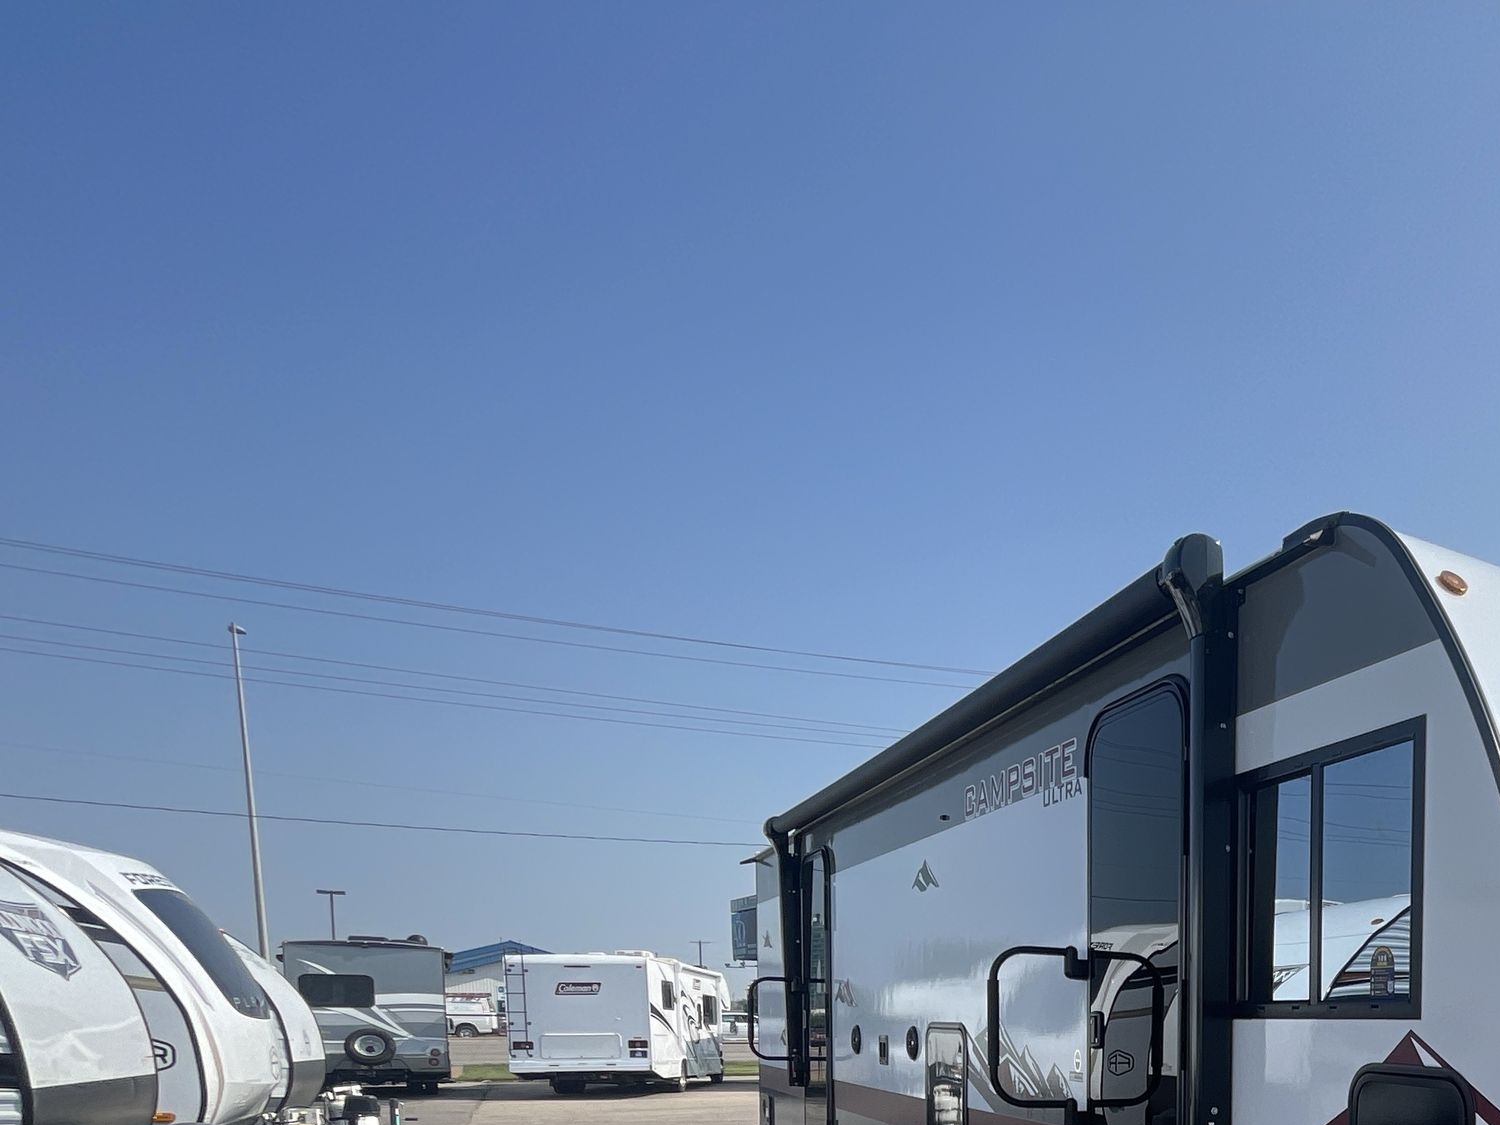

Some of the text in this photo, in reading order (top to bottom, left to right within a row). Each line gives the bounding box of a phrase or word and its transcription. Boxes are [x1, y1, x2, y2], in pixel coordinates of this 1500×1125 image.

[965, 737, 1077, 820] CAMPSITE
[1043, 778, 1082, 807] ULTRA
[558, 983, 591, 992] Coleman
